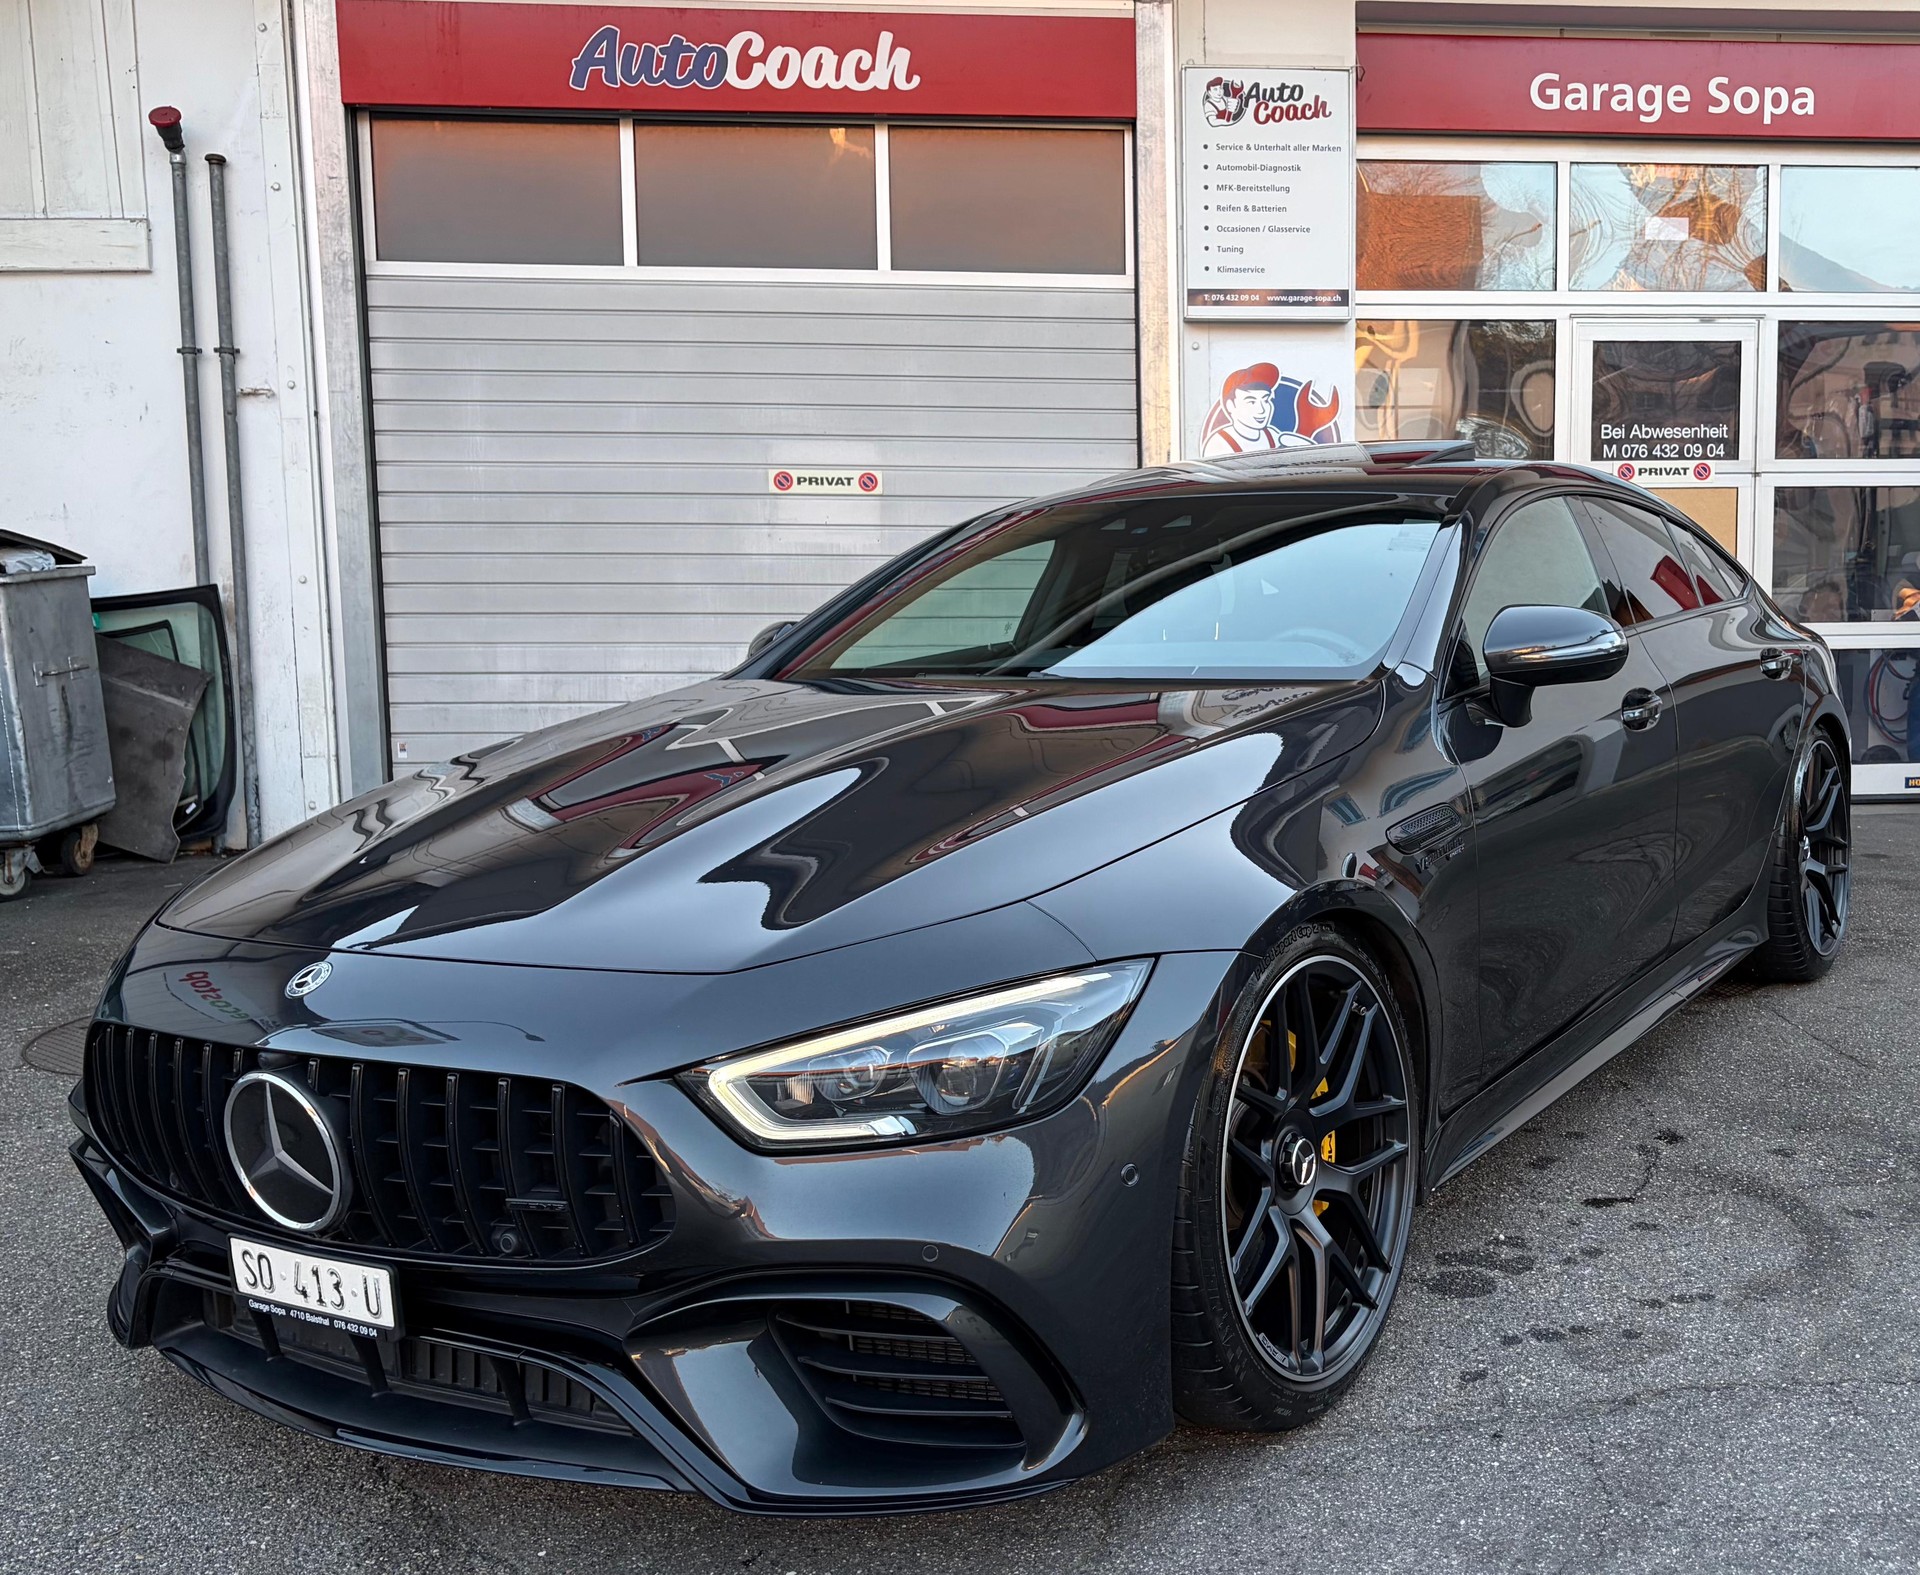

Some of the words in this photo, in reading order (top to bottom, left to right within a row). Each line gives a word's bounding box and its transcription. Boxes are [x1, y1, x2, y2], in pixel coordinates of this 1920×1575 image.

[1243, 82, 1304, 108] Auto
[1529, 72, 1691, 123] Garage
[1707, 76, 1815, 125] Sopa
[1253, 95, 1332, 125] Coach
[1215, 143, 1244, 152] Service
[1245, 143, 1252, 152] &
[1253, 143, 1292, 152] Unterhalt
[1292, 144, 1310, 152] aller
[1311, 144, 1342, 153] Marken
[1215, 163, 1302, 173] Automobil-Diagnostik
[1216, 184, 1291, 194] MFK-Bereitstellung
[1216, 204, 1241, 213] Reifen
[1243, 204, 1250, 213] &
[1251, 204, 1288, 213] Batterien
[1216, 224, 1261, 233] Occasionen
[1267, 225, 1311, 234] Glasservice
[1216, 245, 1244, 255] Tuning
[1216, 265, 1266, 274] Klimaservice
[1203, 294, 1210, 302] T:
[1211, 294, 1225, 302] 076
[1225, 294, 1239, 302] 432
[1239, 294, 1250, 302] 09
[1250, 294, 1260, 302] 04
[1266, 294, 1342, 303] www.garage-sopa.ch
[1600, 423, 1625, 439] Bei
[1629, 423, 1729, 439] Abwesenheit
[1603, 444, 1617, 459] M
[1621, 444, 1648, 458] 076
[1652, 444, 1679, 458] 432
[1683, 444, 1703, 458] 09
[1707, 443, 1725, 458] 04
[1638, 467, 1690, 476] PRIVAT
[796, 476, 854, 486] PRIVAT
[241, 1249, 276, 1293] SO
[293, 1258, 345, 1311] 413
[361, 1270, 382, 1320] U
[248, 1298, 269, 1312] Garage
[270, 1303, 286, 1316] Sopa
[289, 1309, 305, 1320] 4710
[305, 1312, 330, 1326] Balsthal
[333, 1319, 346, 1330] 076
[346, 1322, 359, 1333] 432
[359, 1325, 368, 1336] 09
[368, 1328, 377, 1338] 04
